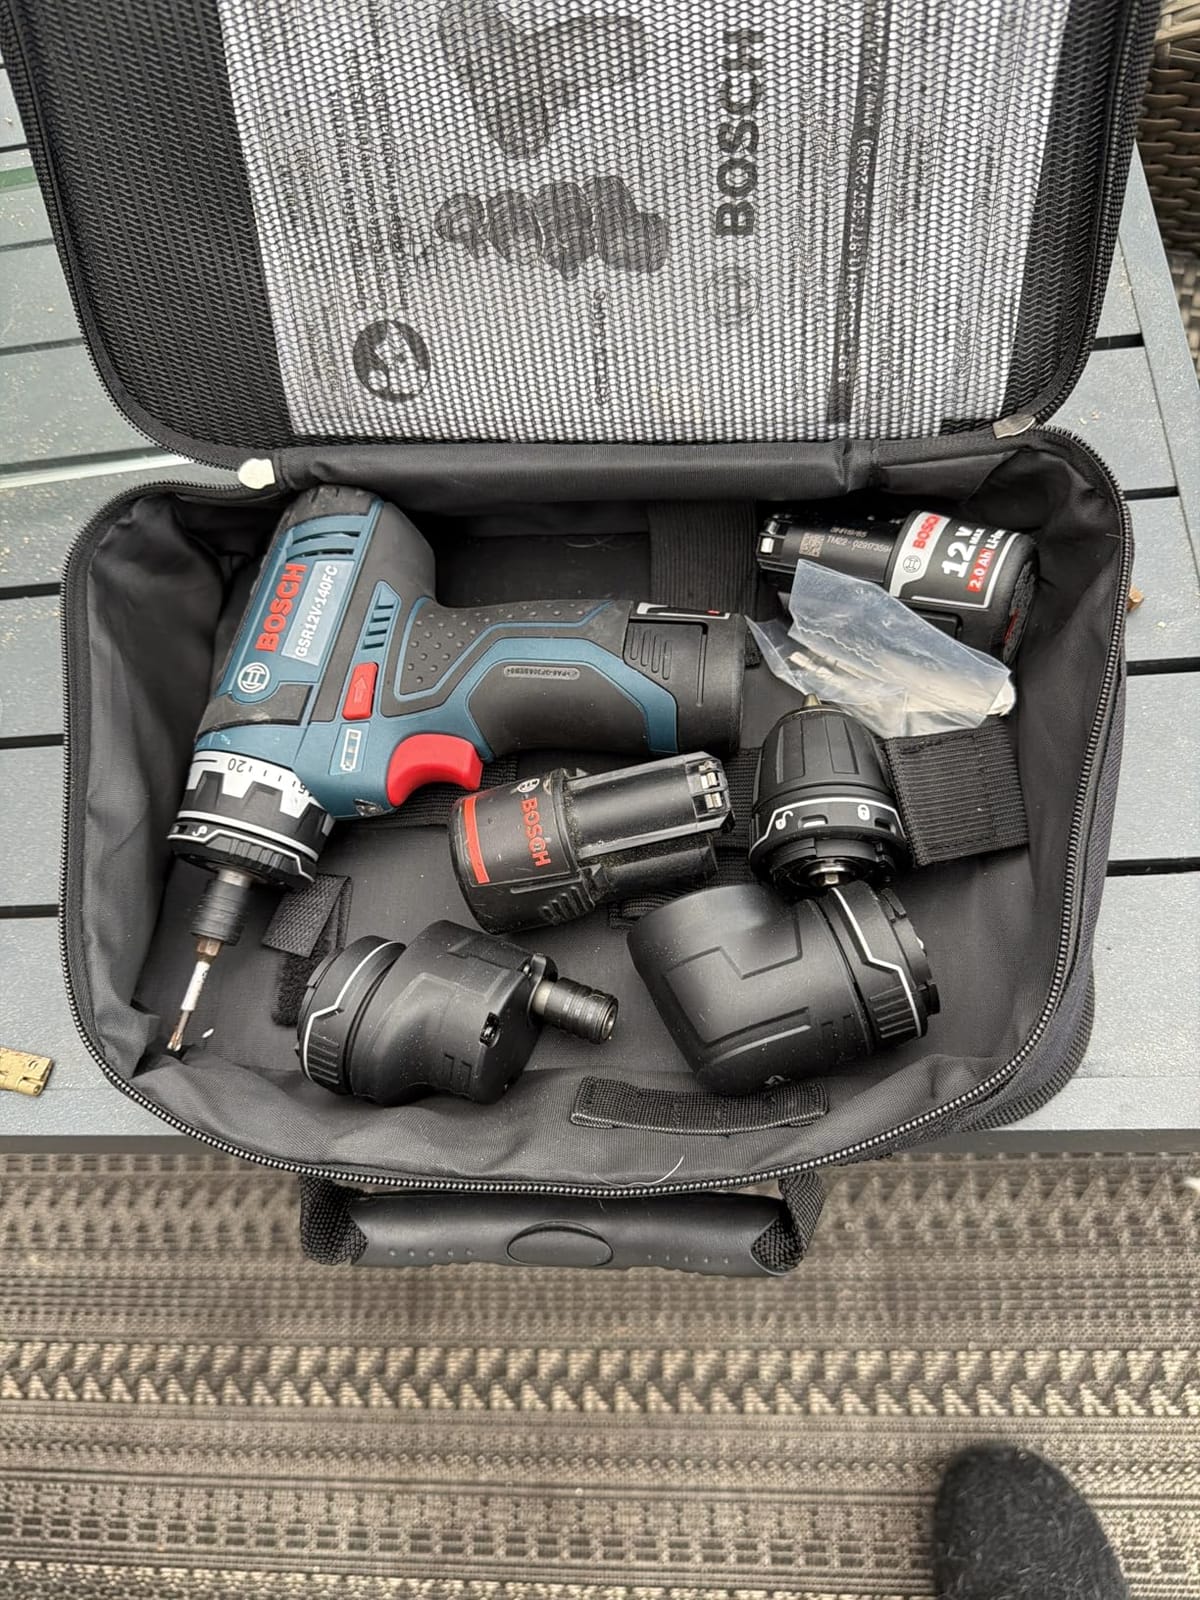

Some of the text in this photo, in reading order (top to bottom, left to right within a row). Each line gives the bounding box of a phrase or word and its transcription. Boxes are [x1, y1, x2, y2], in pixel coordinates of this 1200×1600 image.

[716, 29, 765, 238] BOSCH
[940, 526, 977, 579] 12 V
[969, 568, 987, 591] 2.0
[978, 551, 995, 568] Ah
[254, 563, 309, 653] BOSCH
[294, 565, 339, 658] GSR12V-140FC
[228, 757, 247, 774] 20
[520, 796, 552, 868] BOSCH
